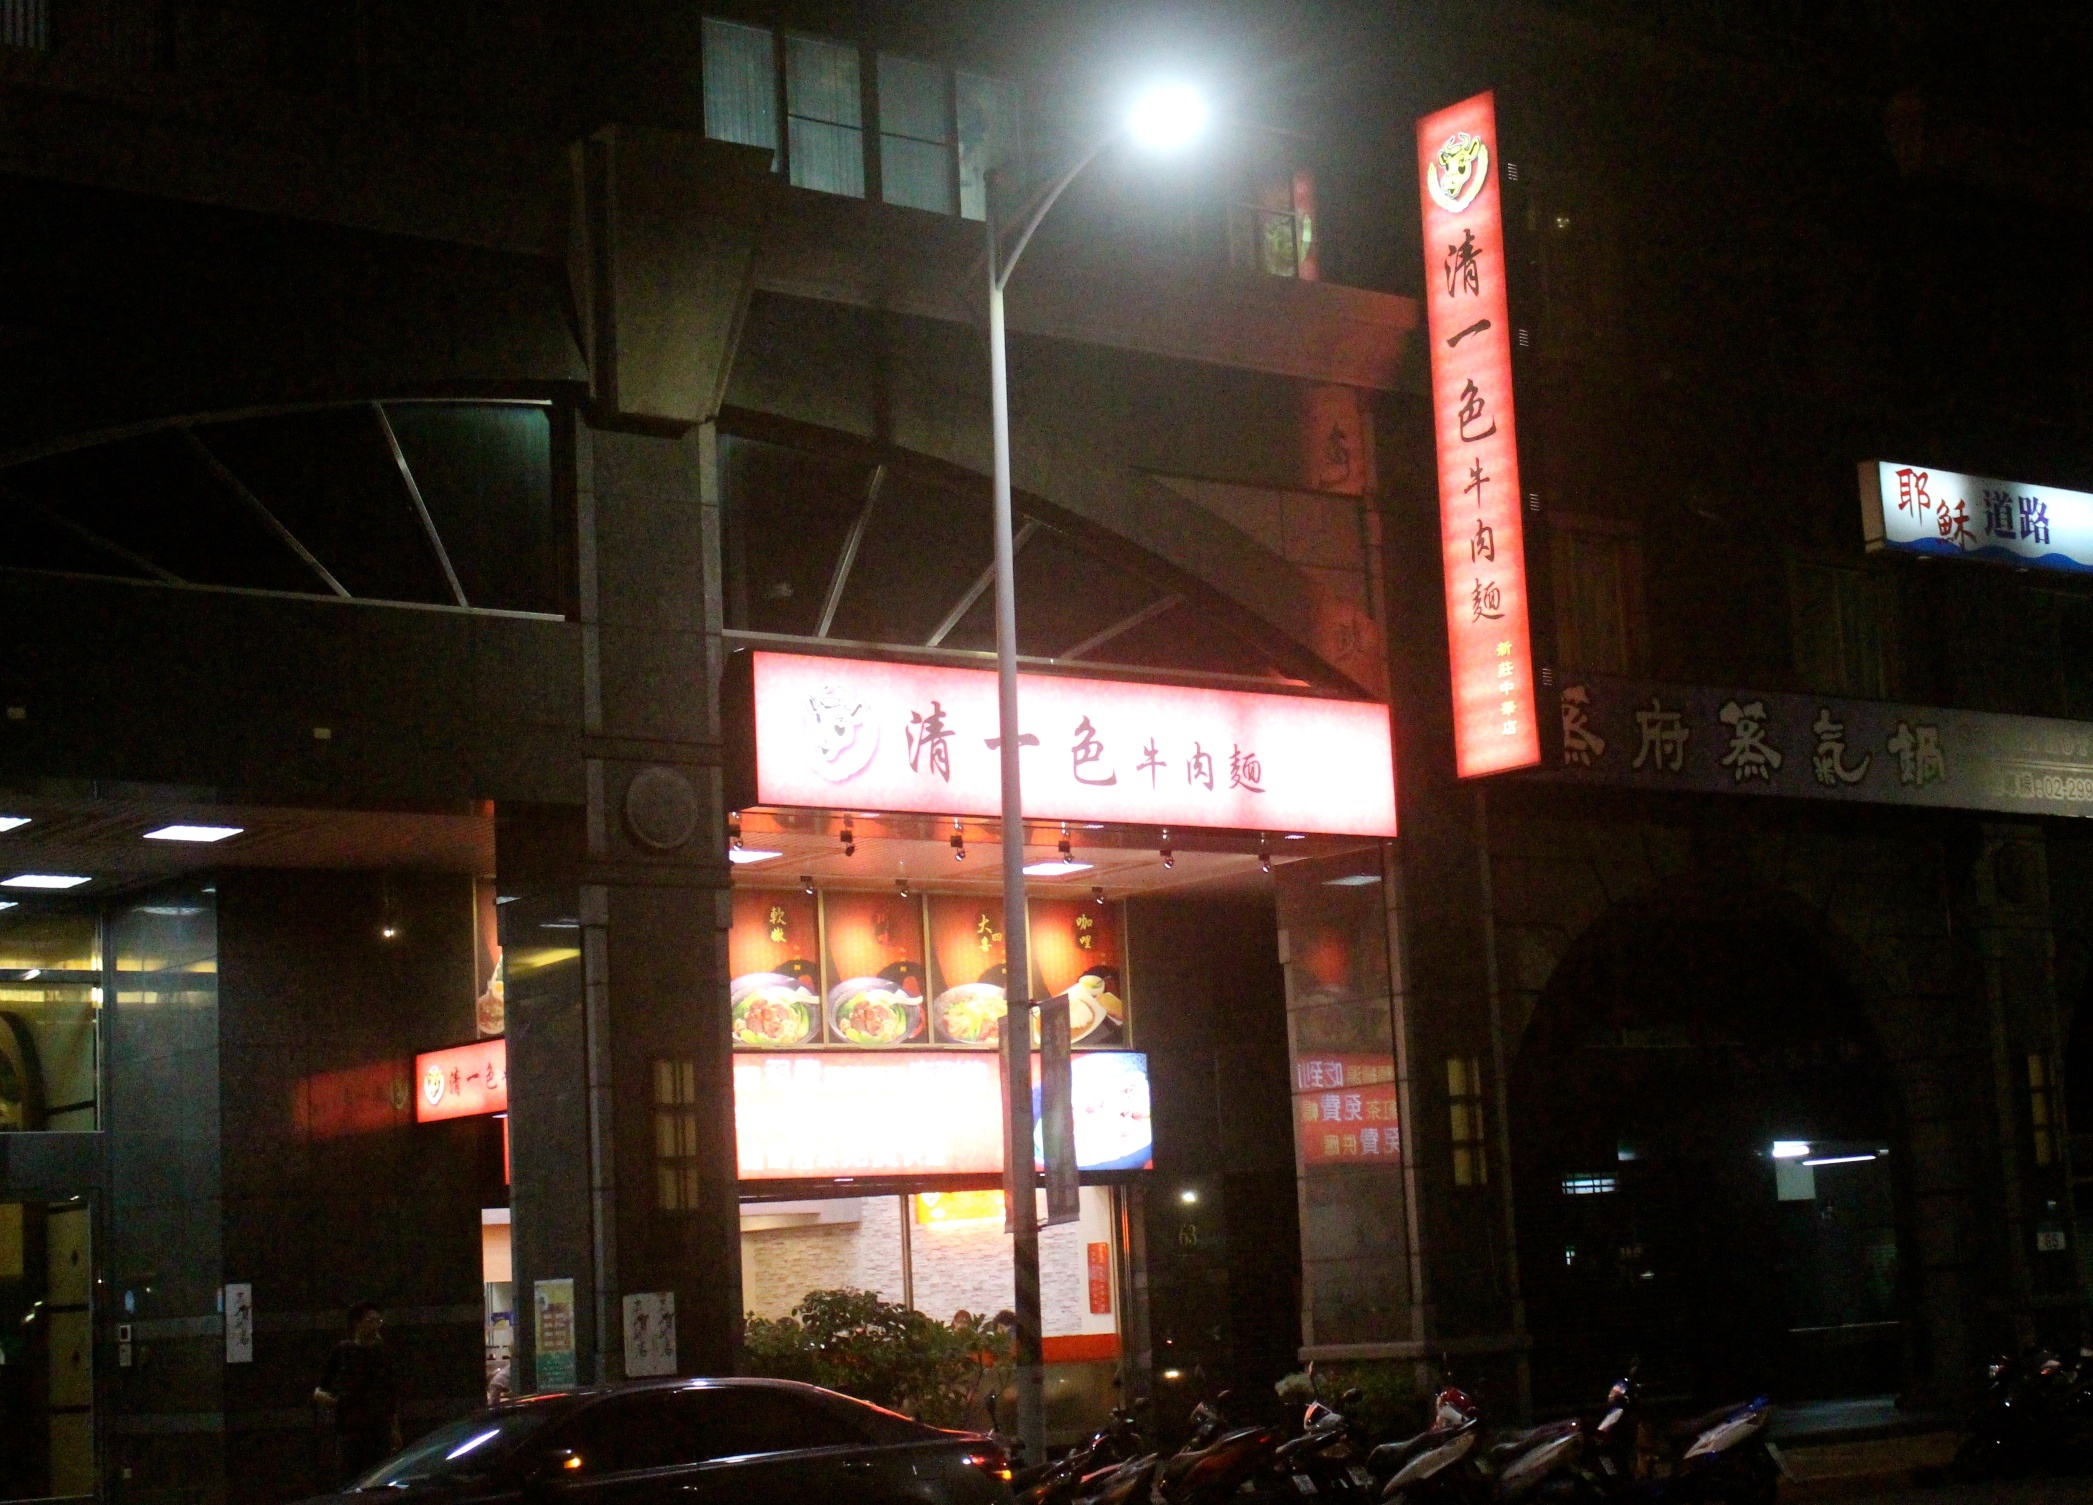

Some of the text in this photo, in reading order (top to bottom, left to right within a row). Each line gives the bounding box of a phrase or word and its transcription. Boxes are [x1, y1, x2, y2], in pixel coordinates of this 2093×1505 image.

[1445, 228, 1505, 624] 清一色牛肉麵
[1895, 468, 2050, 550] 耶穌道路
[905, 700, 1266, 794] 清一色牛肉麵
[1076, 913, 1093, 949] 咖哩
